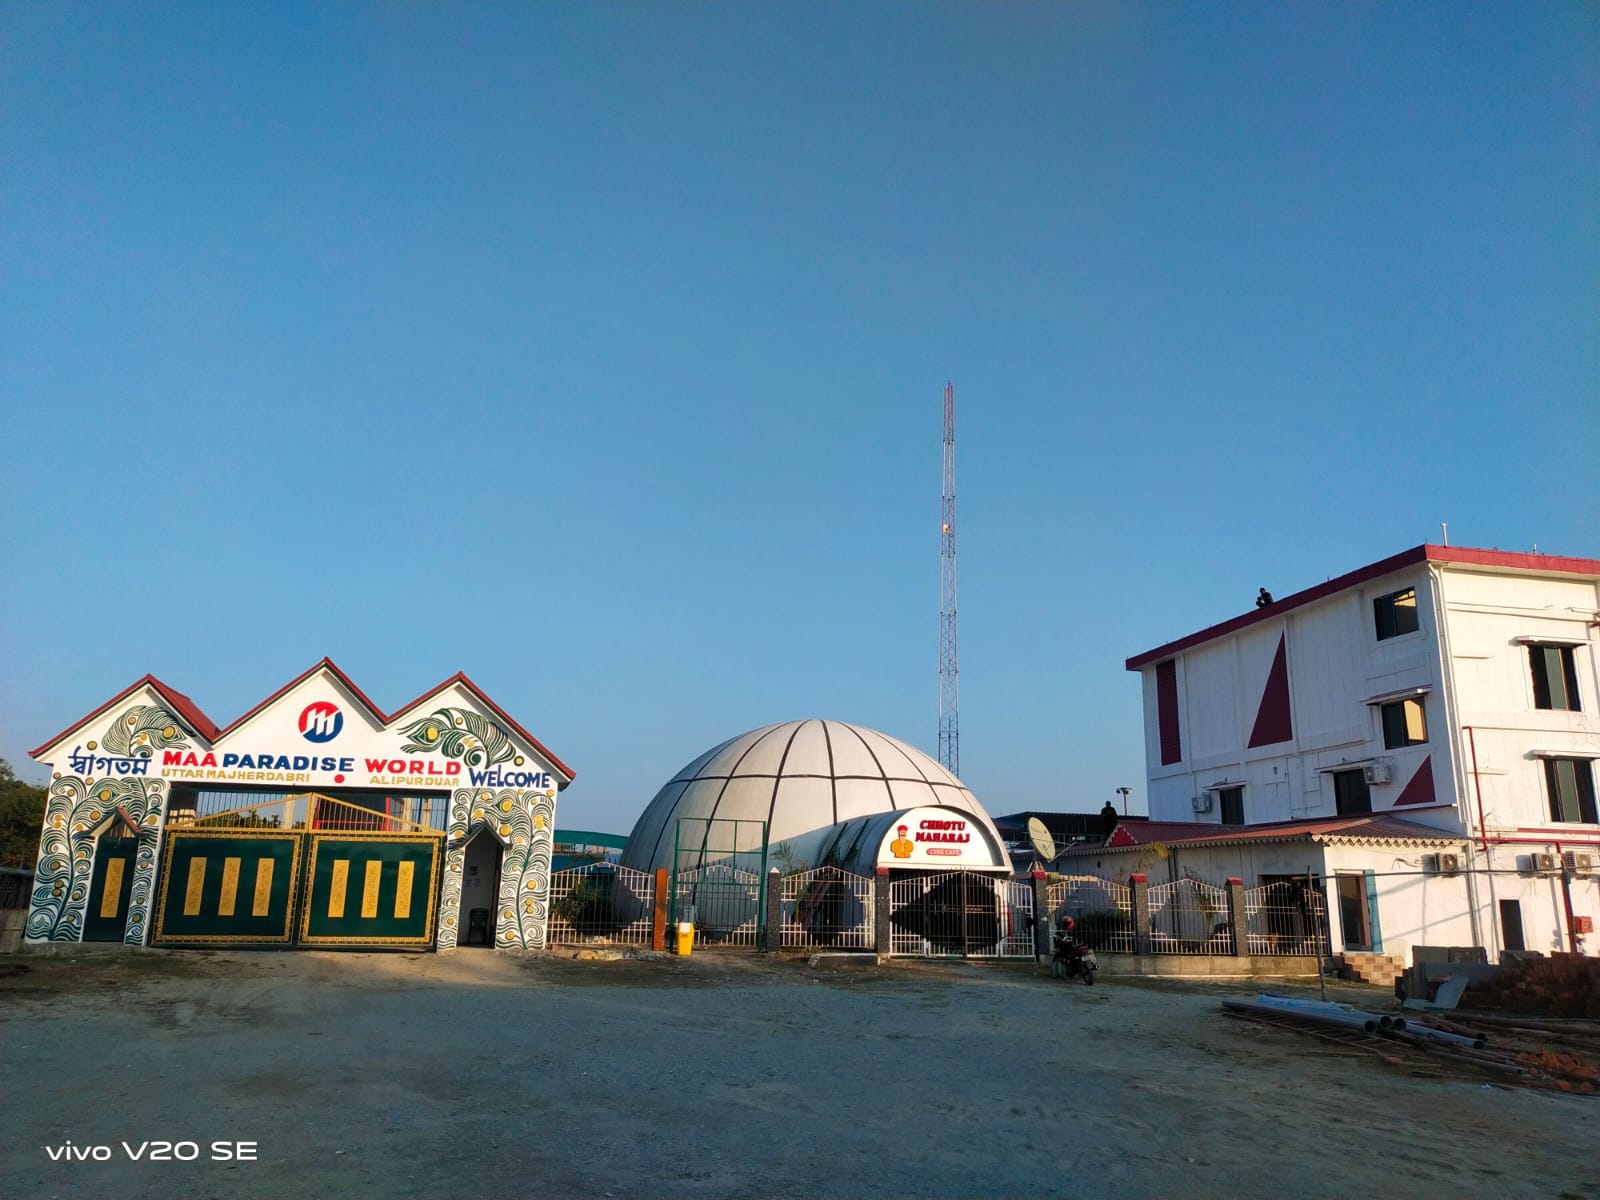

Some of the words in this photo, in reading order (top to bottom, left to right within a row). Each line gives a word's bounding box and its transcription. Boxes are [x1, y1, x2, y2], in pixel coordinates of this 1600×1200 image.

[163, 751, 218, 767] MAA
[223, 753, 355, 772] PARADISE
[364, 758, 461, 776] WORLD
[162, 768, 203, 778] UTTAR
[369, 775, 460, 787] ALIPURDUAR
[468, 764, 551, 789] WELCOME
